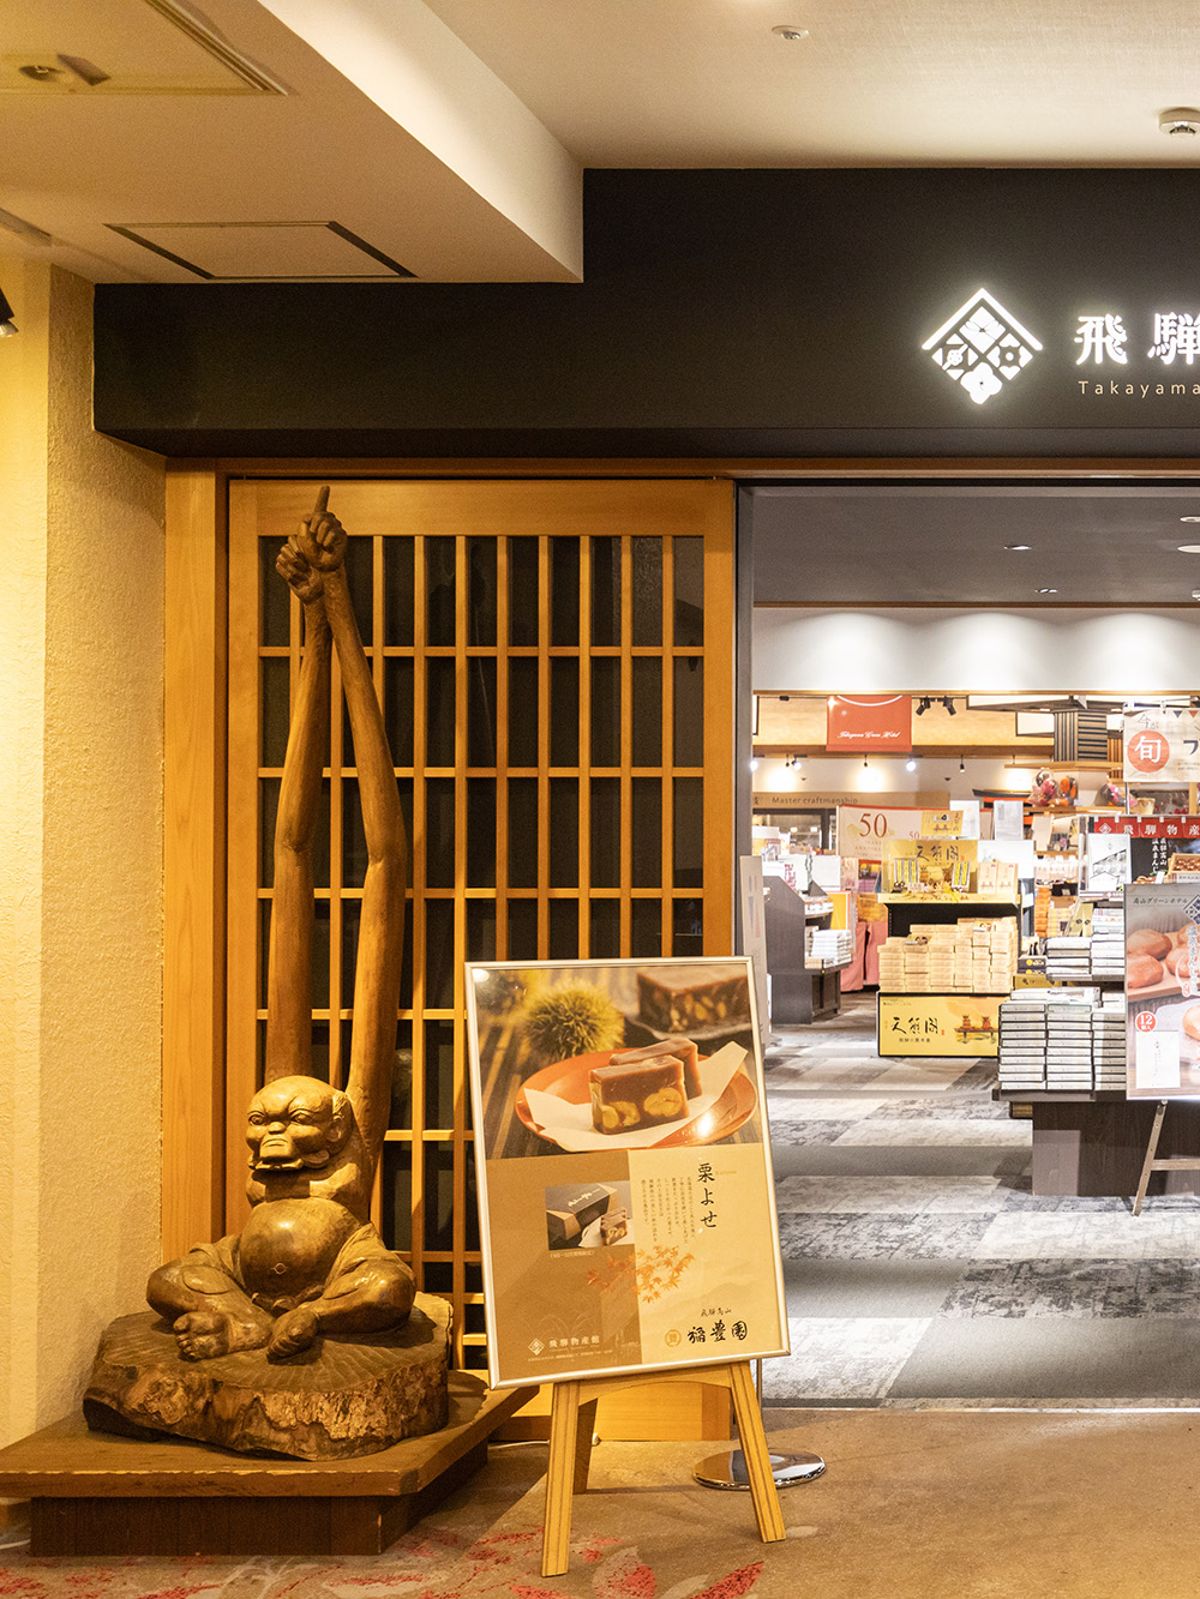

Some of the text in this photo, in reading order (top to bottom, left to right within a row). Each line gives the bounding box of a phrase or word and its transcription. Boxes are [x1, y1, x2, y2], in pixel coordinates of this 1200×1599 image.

[1134, 735, 1162, 763] 旬
[859, 813, 888, 838] 50
[1140, 1014, 1153, 1025] 12
[697, 1162, 718, 1228] 栗よせ
